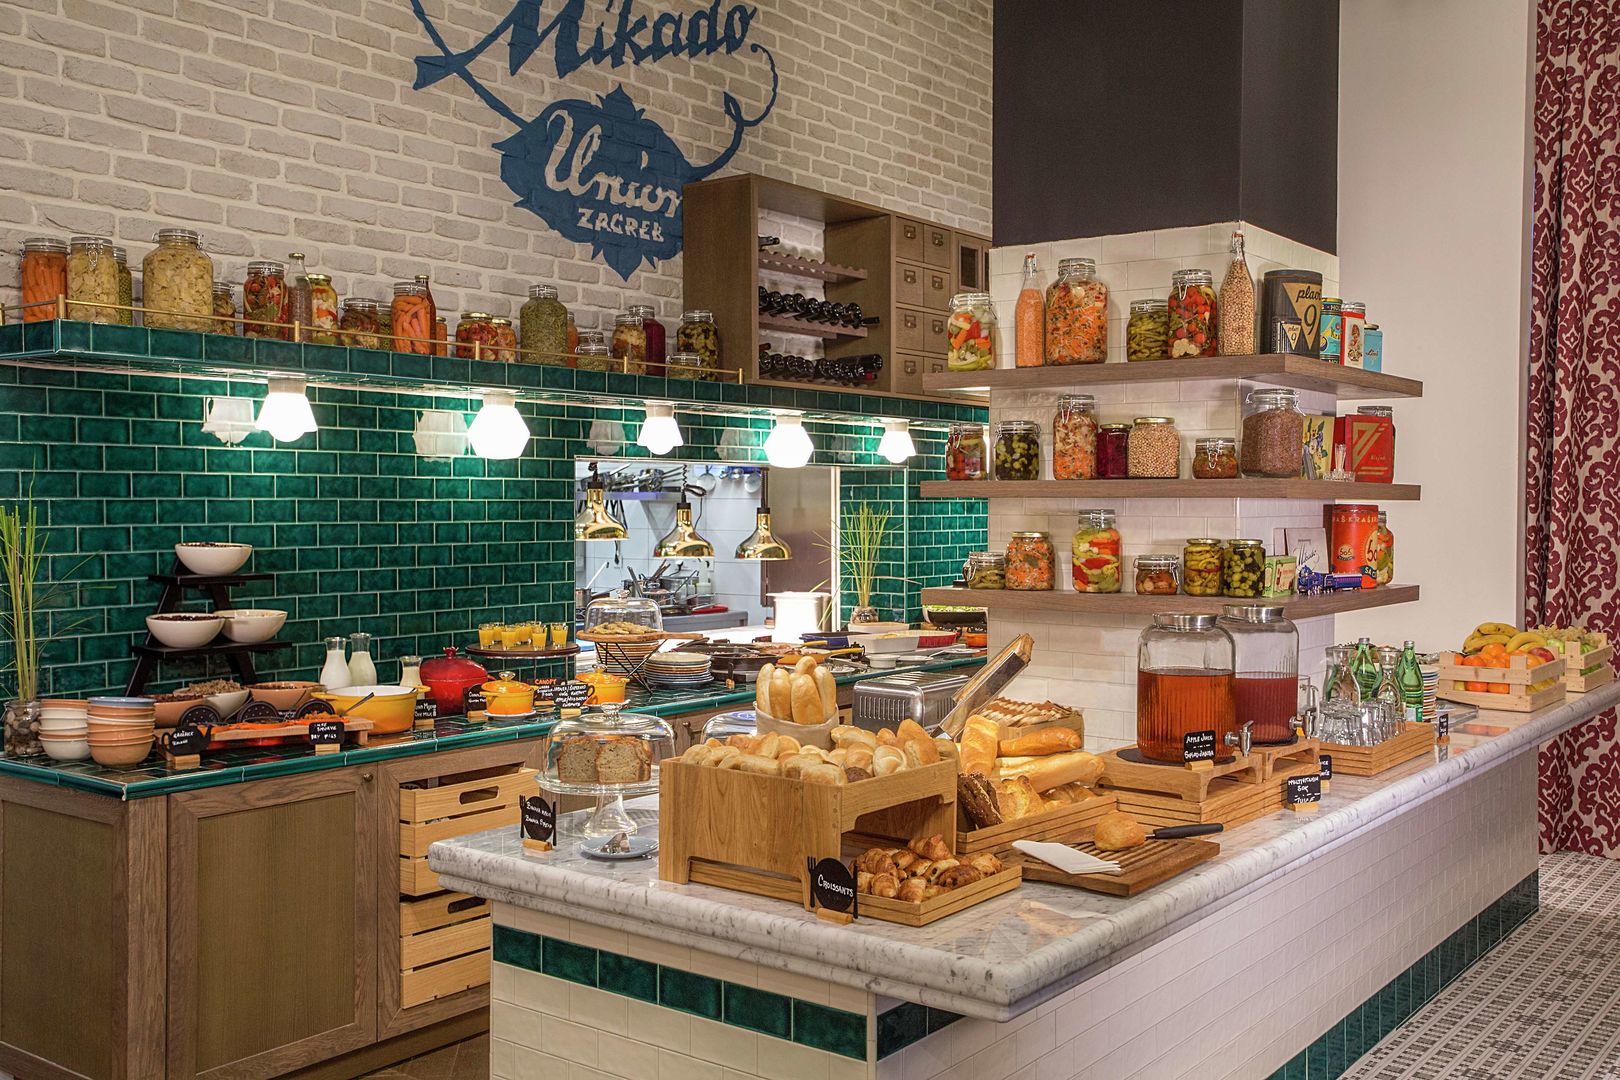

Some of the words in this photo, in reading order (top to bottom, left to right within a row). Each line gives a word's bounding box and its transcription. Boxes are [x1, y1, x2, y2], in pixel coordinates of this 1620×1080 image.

[472, 0, 758, 79] Mikado
[577, 207, 665, 243] ZAGREB
[1303, 304, 1317, 335] 9
[817, 873, 854, 898] CROISSANTS
